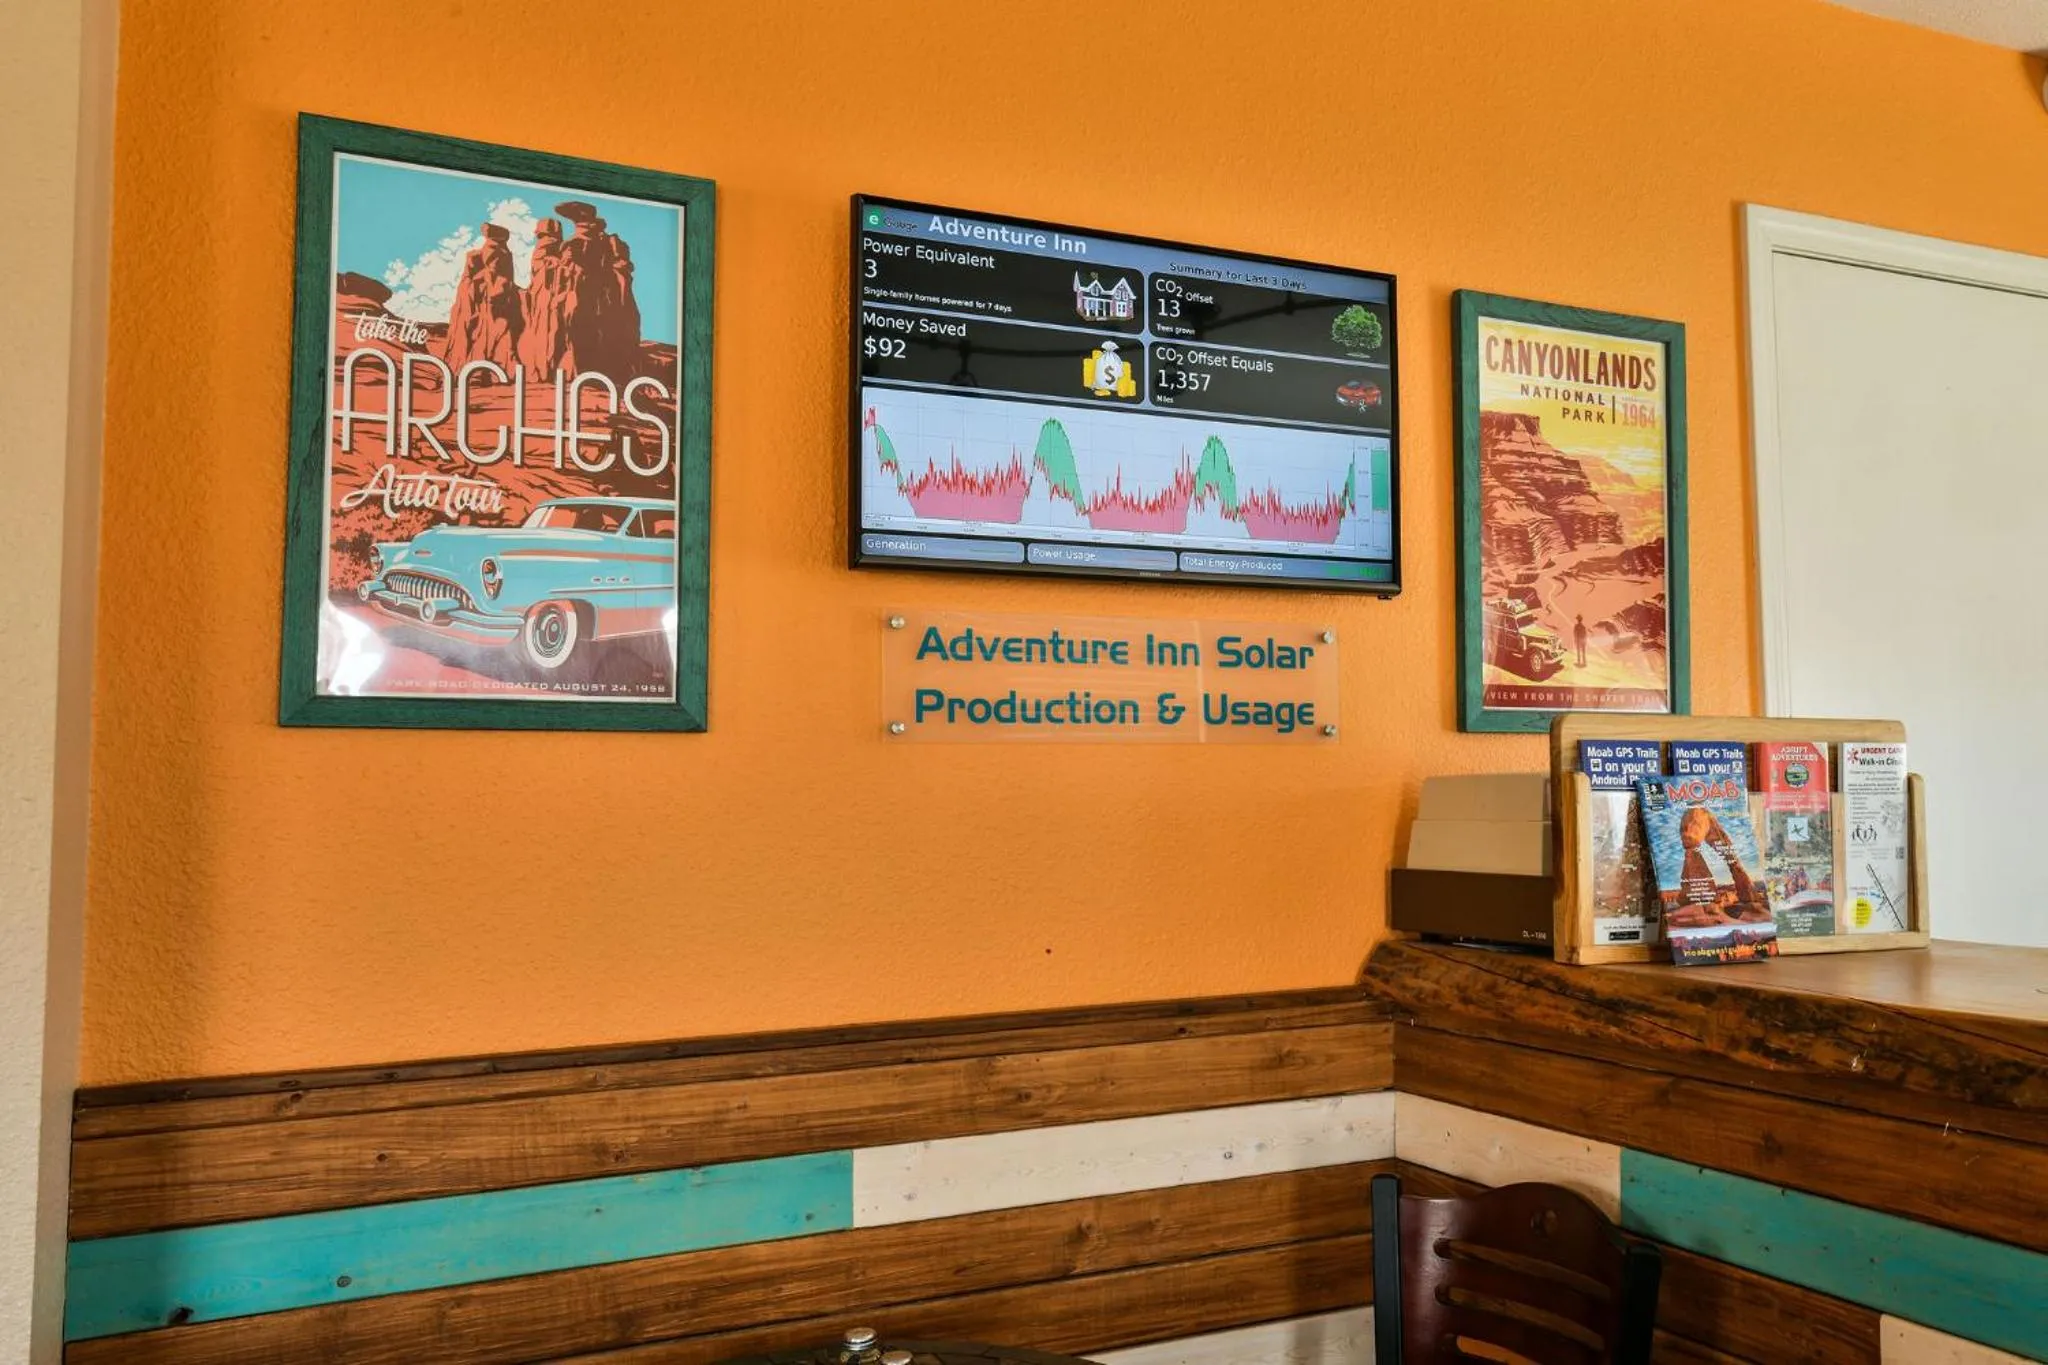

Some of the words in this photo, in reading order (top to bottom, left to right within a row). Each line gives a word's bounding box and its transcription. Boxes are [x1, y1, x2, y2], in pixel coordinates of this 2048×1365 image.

[929, 214, 1047, 249] Adventure
[1054, 233, 1088, 255] Inn
[863, 238, 911, 257] Power
[916, 245, 996, 269] Equivalent
[864, 259, 878, 278] 3
[1170, 262, 1222, 280] Summary
[1226, 270, 1242, 281] for
[1246, 273, 1269, 286] Last
[1272, 277, 1278, 286] 3
[1281, 278, 1308, 290] Days
[863, 286, 913, 301] Single-family
[914, 293, 940, 304] homes
[942, 297, 973, 310] powered
[976, 300, 986, 309] for
[988, 302, 993, 310] 7
[995, 303, 1013, 313] days
[1158, 298, 1181, 317] 13
[1185, 292, 1214, 305] Offset
[348, 311, 397, 343] take
[399, 316, 428, 345] the
[863, 311, 914, 333] Money
[919, 317, 967, 337] Saved
[1157, 323, 1174, 333] Trees
[864, 336, 906, 359] $92
[1187, 350, 1228, 368] Offset
[1231, 356, 1274, 374] Equals
[1485, 335, 1657, 391] CANYONLANDS
[1158, 370, 1211, 392] 1,357
[1521, 384, 1606, 406] NATIONAL
[1562, 407, 1605, 424] PARK
[1622, 402, 1656, 429] 1964
[341, 463, 440, 518] Auto
[440, 475, 502, 518] Tour
[866, 538, 926, 552] Generation
[1033, 548, 1063, 559] Power
[1066, 550, 1097, 561] Usage
[1184, 557, 1207, 568] Total
[1209, 559, 1239, 570] Energy
[1240, 561, 1283, 571] Produced
[916, 626, 1130, 665] Adventure
[1147, 634, 1200, 666] Inn
[1216, 636, 1315, 669] Solar
[429, 680, 468, 689] ROAD
[471, 681, 548, 691] DEDICATED
[553, 683, 606, 692] AUGUST
[1490, 691, 1518, 700] VIEW
[1524, 692, 1553, 702] FROM
[1560, 693, 1578, 702] THE
[915, 688, 1140, 725] Production
[1157, 692, 1186, 724] &
[1204, 693, 1315, 733] Usage
[1587, 746, 1613, 758] Moab
[1616, 747, 1634, 758] GPS
[1636, 748, 1658, 758] Trails
[1675, 748, 1701, 759] Moab
[1702, 748, 1720, 759] GPS
[1721, 748, 1744, 759] Trails
[1860, 757, 1884, 766] Walk-in
[1605, 762, 1619, 772] on
[1621, 762, 1645, 775] your
[1692, 763, 1706, 773] on
[1708, 763, 1731, 775] your
[1591, 774, 1627, 786] Android
[1666, 779, 1740, 801] MOAB
